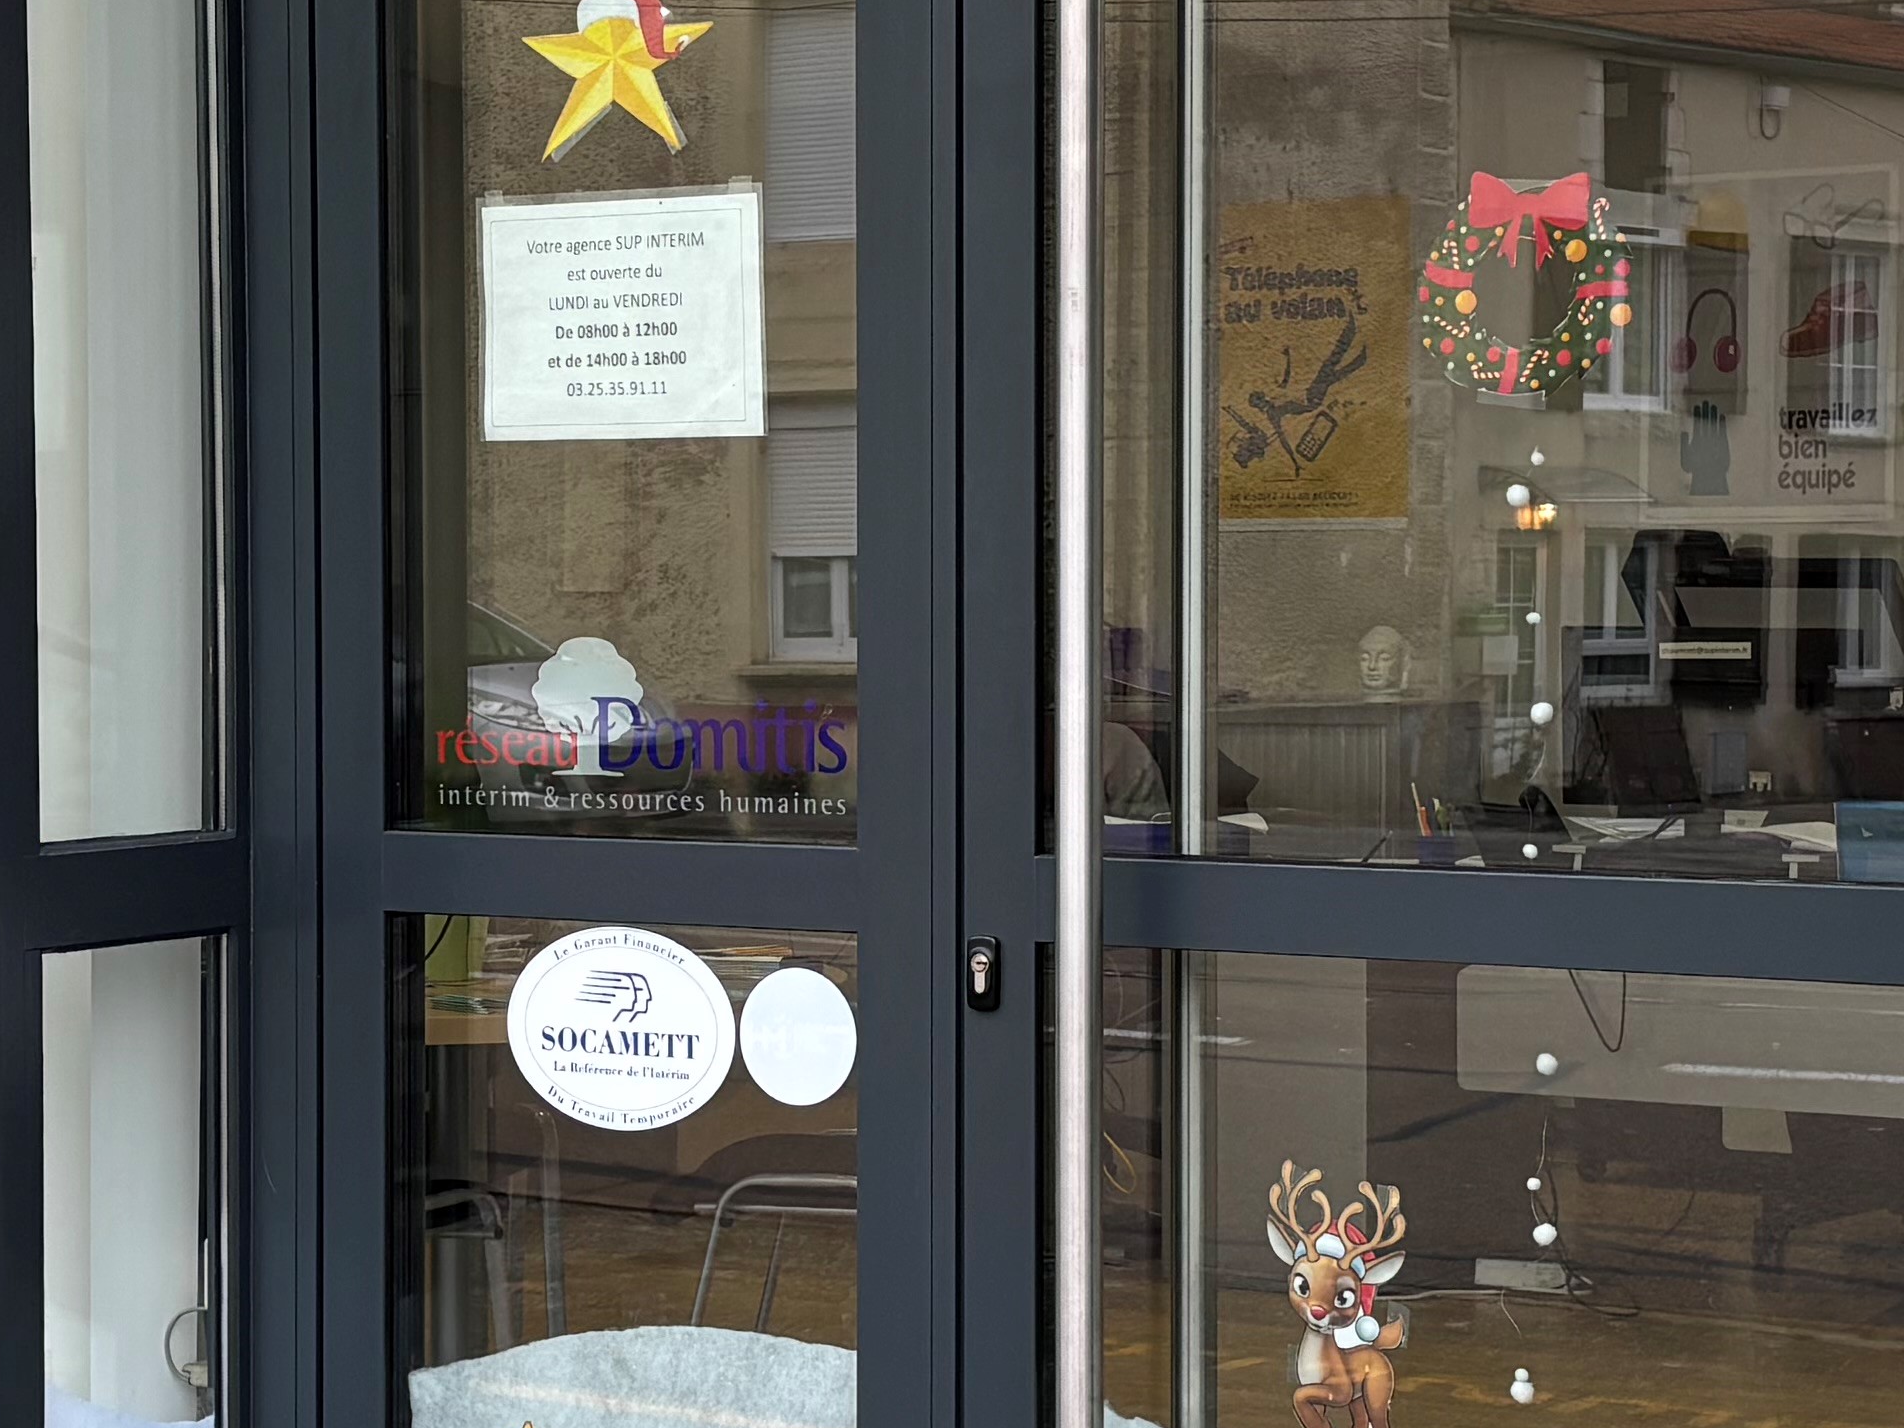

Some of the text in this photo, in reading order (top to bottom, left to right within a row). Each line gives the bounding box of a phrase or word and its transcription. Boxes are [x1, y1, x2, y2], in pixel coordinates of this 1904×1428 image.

[526, 231, 705, 255] Votre agence SUP INTERIM
[567, 263, 663, 281] est ouverte du
[548, 291, 683, 311] LUNDI au VENDREDI
[1224, 299, 1261, 323] au
[555, 321, 678, 340] De 08h00 à 12h00
[547, 350, 687, 369] et de 14h00 à 18h00
[566, 381, 668, 397] 03.25.35.91.11
[1779, 402, 1878, 430] travaillez
[1778, 434, 1827, 460] bien
[1778, 462, 1856, 495] équipé
[435, 696, 849, 774] réseau Domitis
[438, 782, 847, 815] intérim & ressources humaines
[553, 933, 686, 966] Le Garant Financier
[541, 1025, 700, 1060] SOCAMETT
[554, 1060, 566, 1072] La
[627, 1066, 639, 1078] de
[548, 1085, 564, 1104] Du
[571, 1099, 615, 1123] Travail
